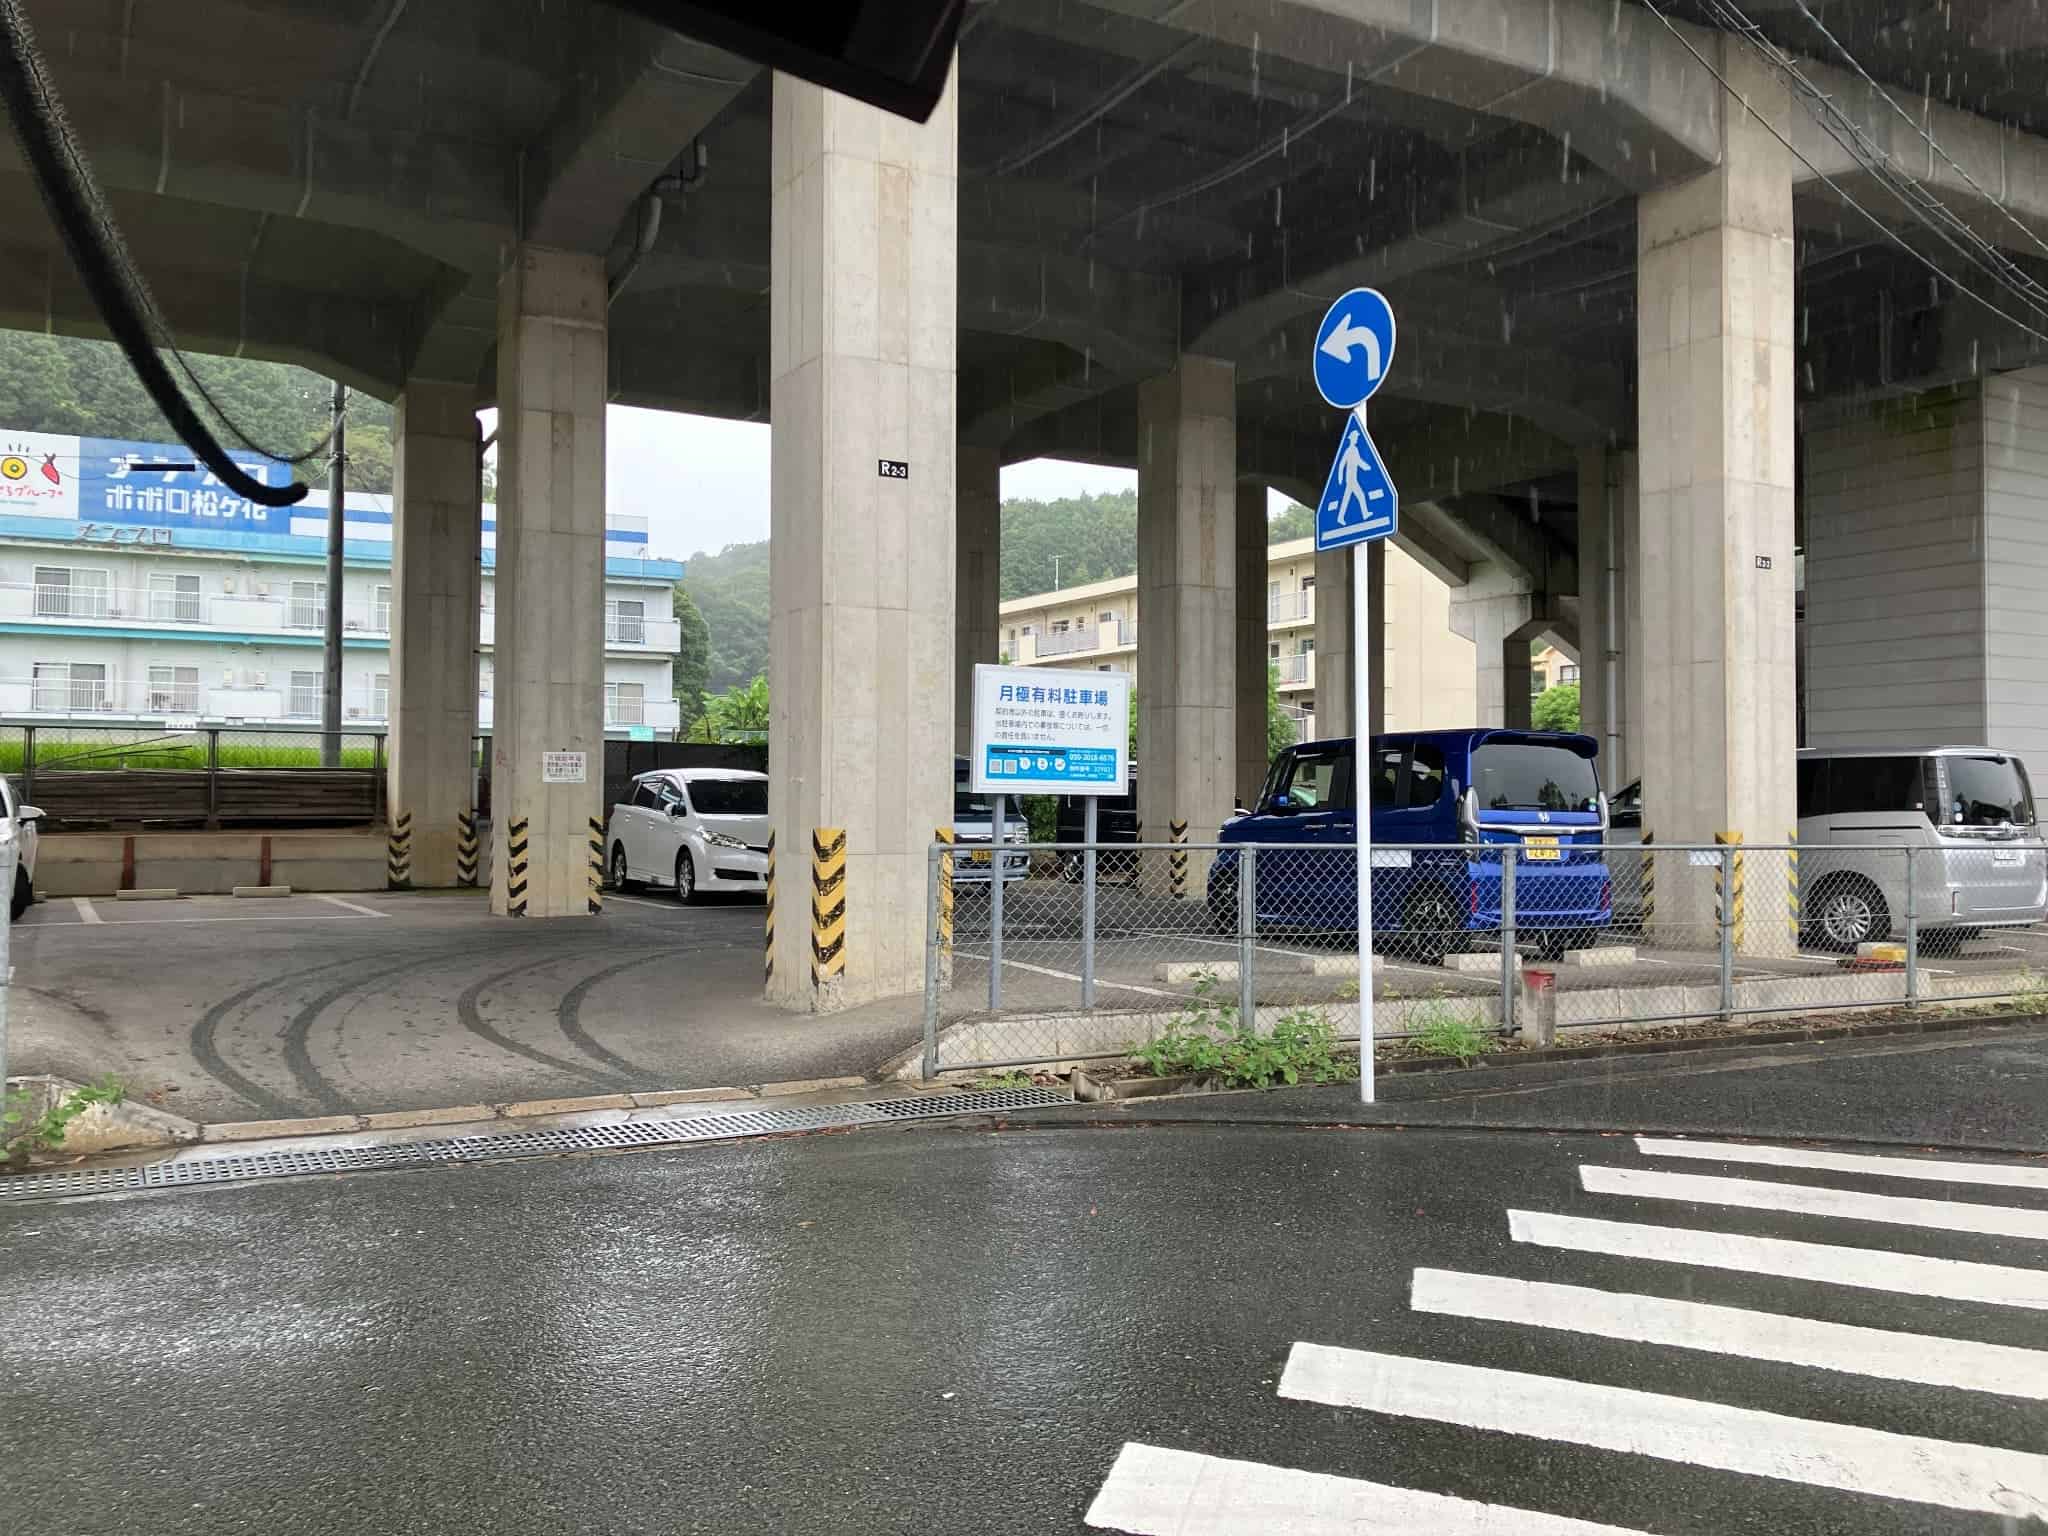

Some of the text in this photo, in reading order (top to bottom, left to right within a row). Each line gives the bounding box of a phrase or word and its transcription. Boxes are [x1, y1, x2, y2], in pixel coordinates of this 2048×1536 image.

[880, 461, 906, 477] R2-3
[999, 685, 1109, 706] 月極有料駐車場
